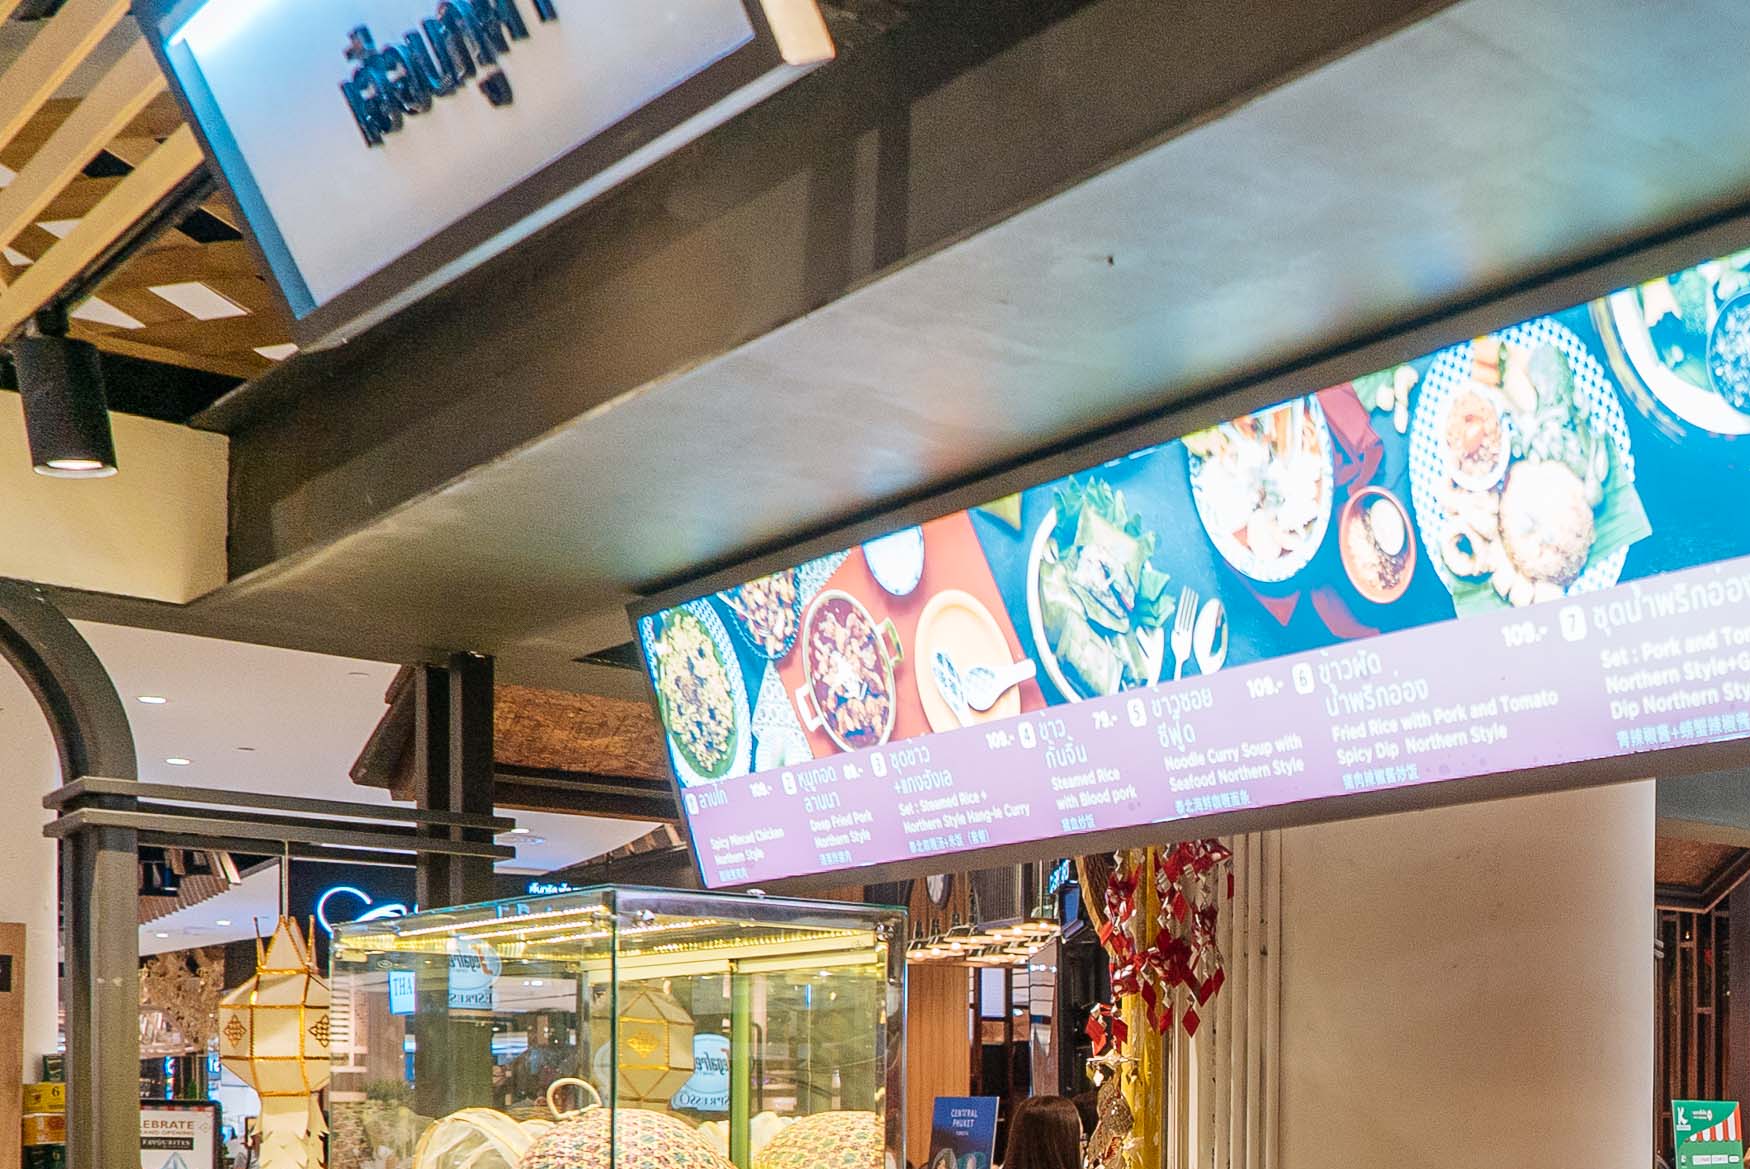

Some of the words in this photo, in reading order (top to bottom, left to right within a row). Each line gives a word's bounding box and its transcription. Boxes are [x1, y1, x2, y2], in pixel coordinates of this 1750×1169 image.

[1317, 648, 1383, 685] ข้าวผัด
[1600, 644, 1628, 669] Set
[1642, 636, 1681, 662] Pork
[1685, 628, 1718, 654] and
[1606, 662, 1681, 694] Northern
[1151, 686, 1214, 718] ข้าวซอย
[1332, 723, 1366, 743] Fried
[1369, 717, 1398, 737] Rice
[1401, 710, 1432, 730] with
[1433, 705, 1468, 725] Pork
[1470, 699, 1498, 718] and
[1499, 688, 1559, 713] Tomato
[1611, 696, 1640, 721] Dip
[1643, 683, 1720, 715] Northern
[1164, 752, 1206, 771] Noodle
[1207, 746, 1240, 766] Curry
[1240, 740, 1273, 760] Soup
[1274, 734, 1303, 752] with
[1336, 746, 1372, 767] Spicy
[1375, 741, 1399, 760] Dip
[1405, 730, 1468, 754] Northern
[1471, 721, 1508, 744] Style
[1051, 769, 1095, 791] Steamed
[1096, 768, 1121, 782] Rice
[1168, 773, 1217, 792] Seafood
[1218, 765, 1271, 784] Northern
[1272, 756, 1304, 777] Style
[1055, 793, 1079, 811] with
[1079, 788, 1112, 806] Blood
[1112, 784, 1138, 804] pork
[903, 817, 943, 834] Northern
[141, 1119, 195, 1130] EBRATE
